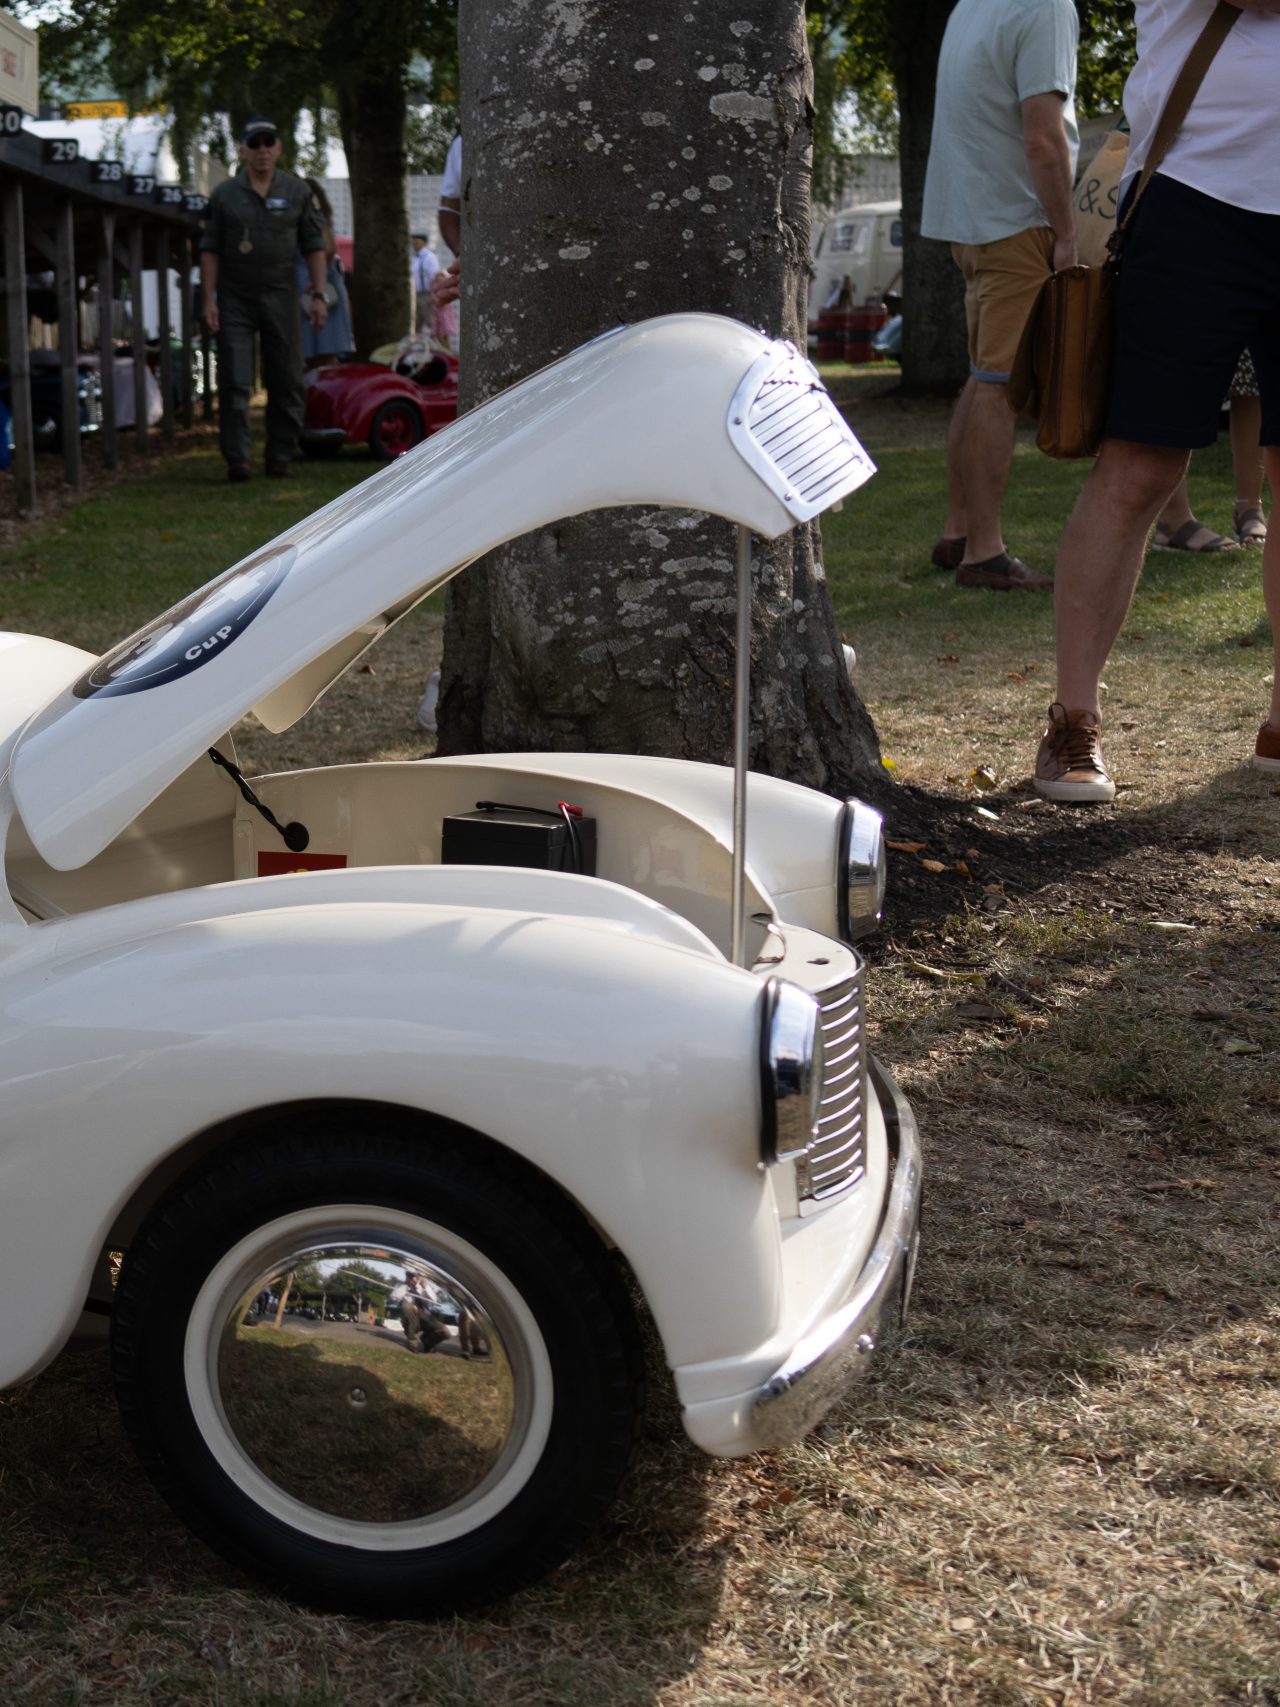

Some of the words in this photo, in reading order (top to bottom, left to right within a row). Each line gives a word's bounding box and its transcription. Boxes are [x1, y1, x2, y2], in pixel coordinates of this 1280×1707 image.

[51, 142, 77, 160] 29
[98, 163, 122, 180] 28
[133, 177, 154, 194] 27
[162, 187, 182, 203] 26
[184, 625, 232, 661] Cup
